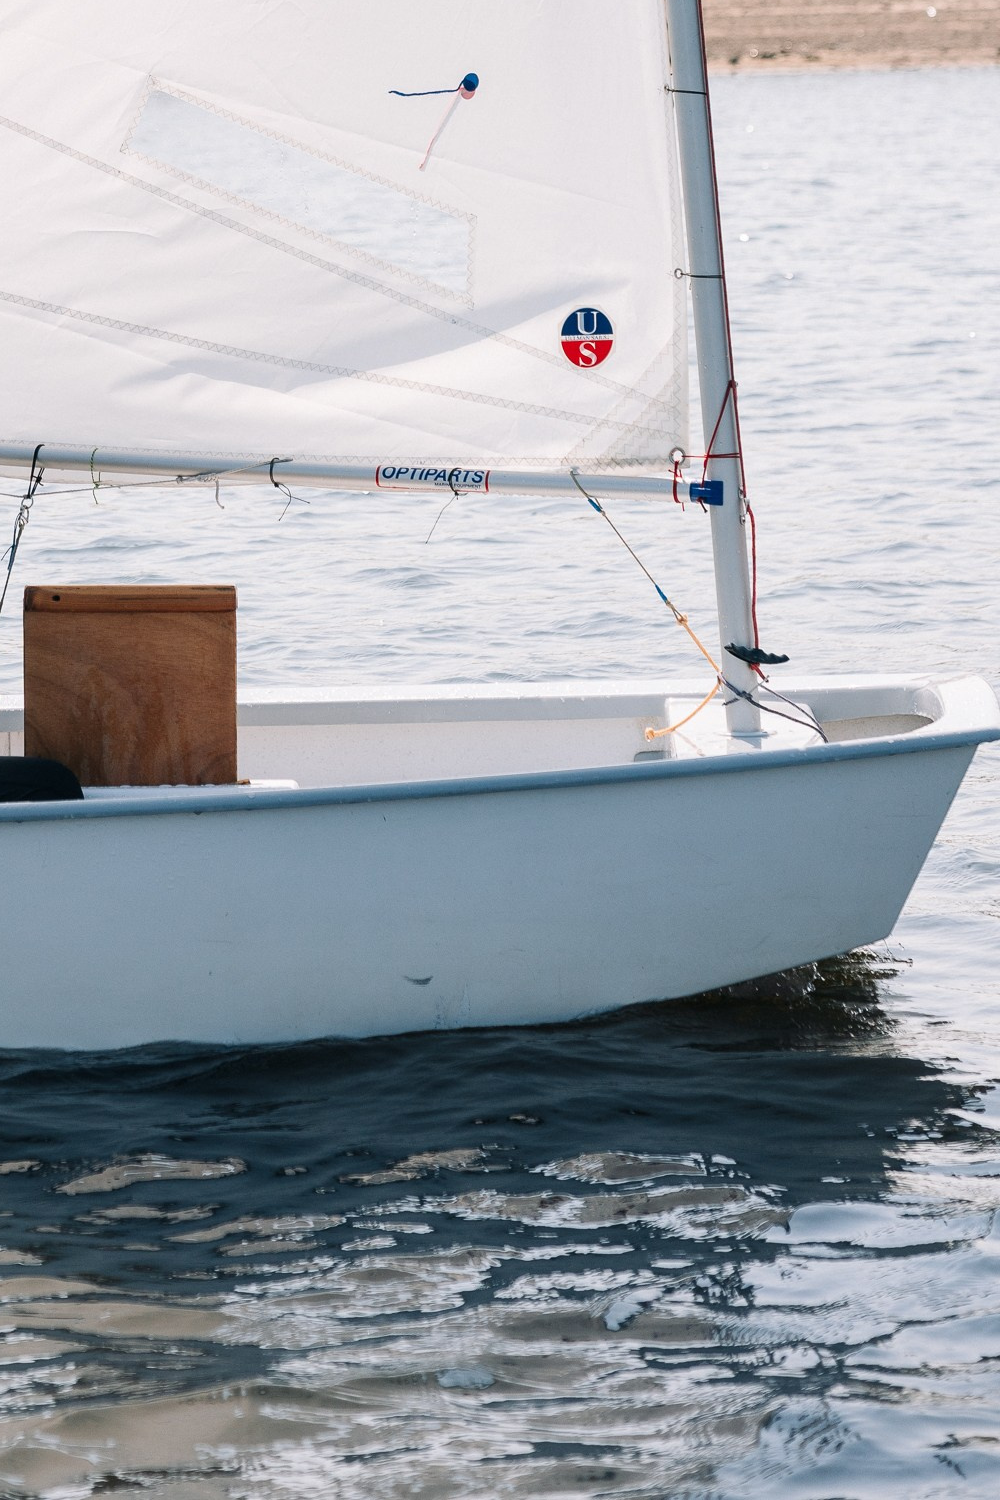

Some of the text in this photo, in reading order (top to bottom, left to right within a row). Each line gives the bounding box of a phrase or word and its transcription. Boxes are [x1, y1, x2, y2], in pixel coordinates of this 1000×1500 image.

[576, 311, 599, 335] U
[579, 341, 598, 367] S
[381, 466, 485, 484] OPTIPARTS
